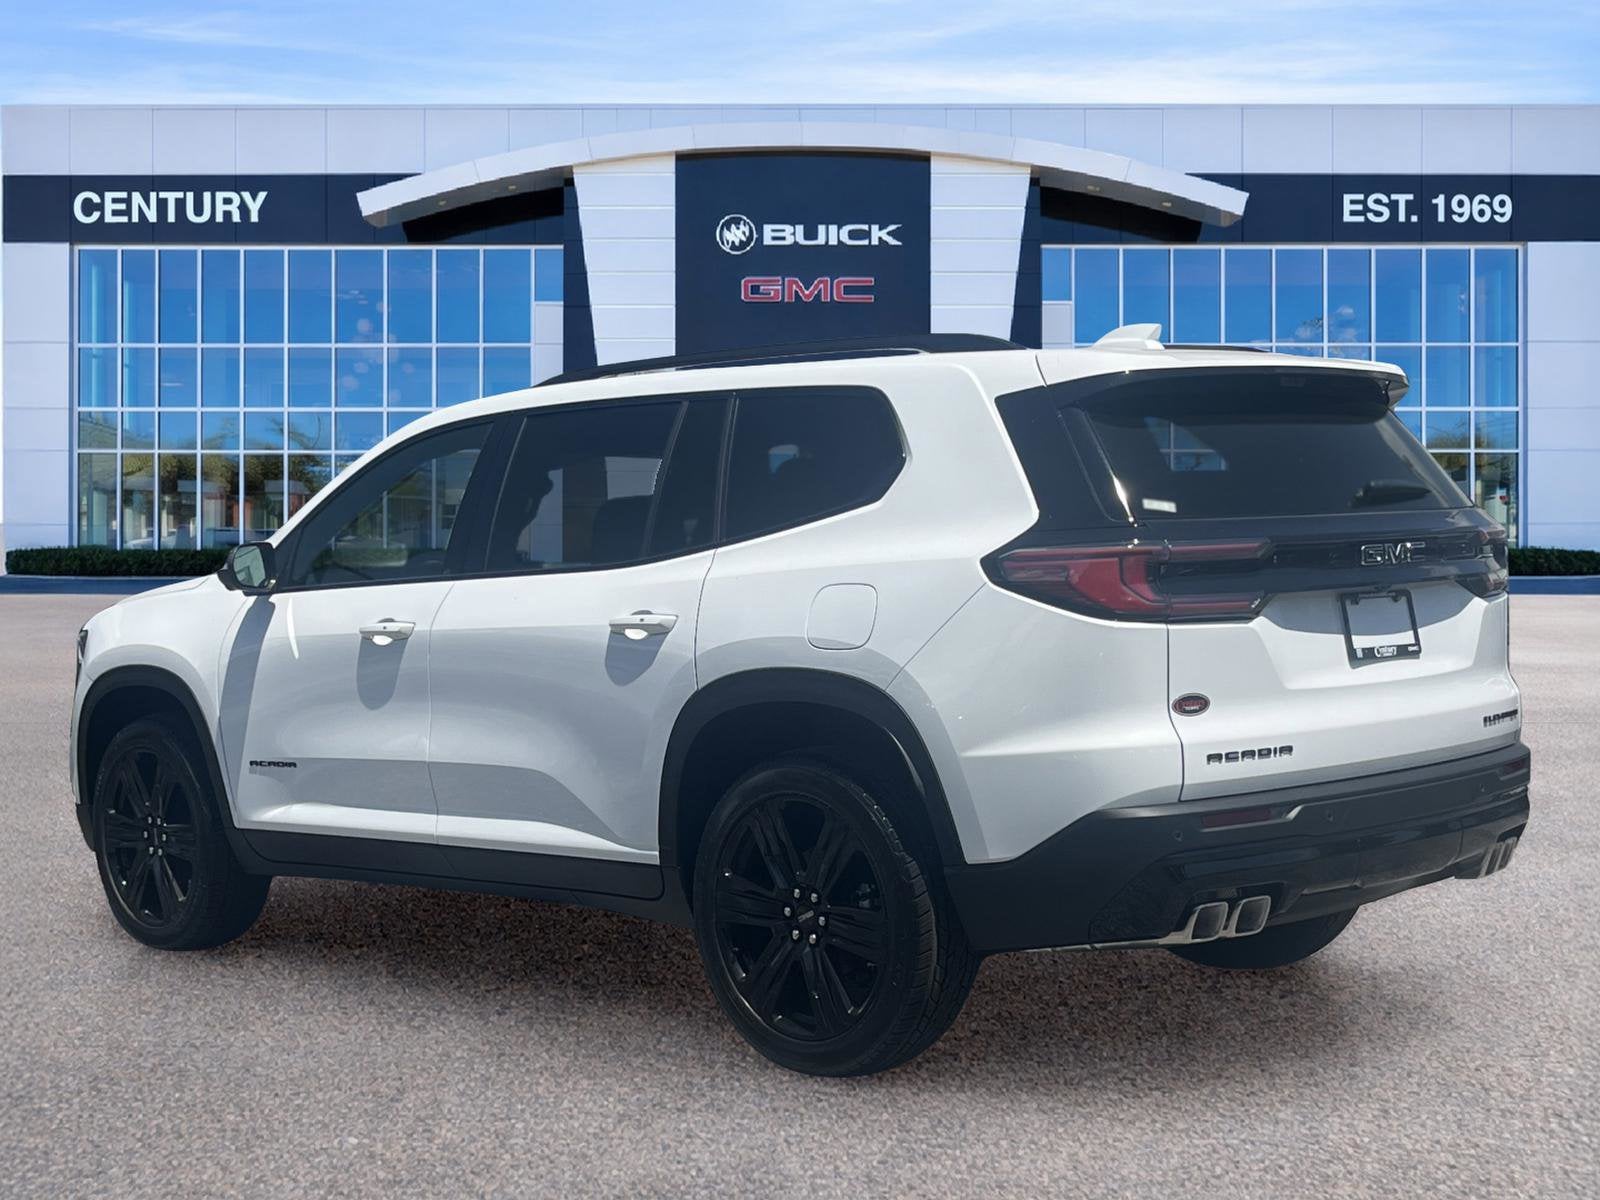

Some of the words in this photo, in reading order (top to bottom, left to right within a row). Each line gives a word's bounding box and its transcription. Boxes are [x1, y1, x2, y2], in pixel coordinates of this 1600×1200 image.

[73, 190, 268, 224] CENTURY
[1342, 193, 1418, 223] EST.
[1431, 193, 1513, 223] 1969
[763, 224, 902, 245] BUICK
[741, 277, 874, 302] GMC
[1361, 541, 1426, 566] GMC
[249, 760, 297, 768] ACADIA
[1206, 745, 1293, 765] ACADIA
